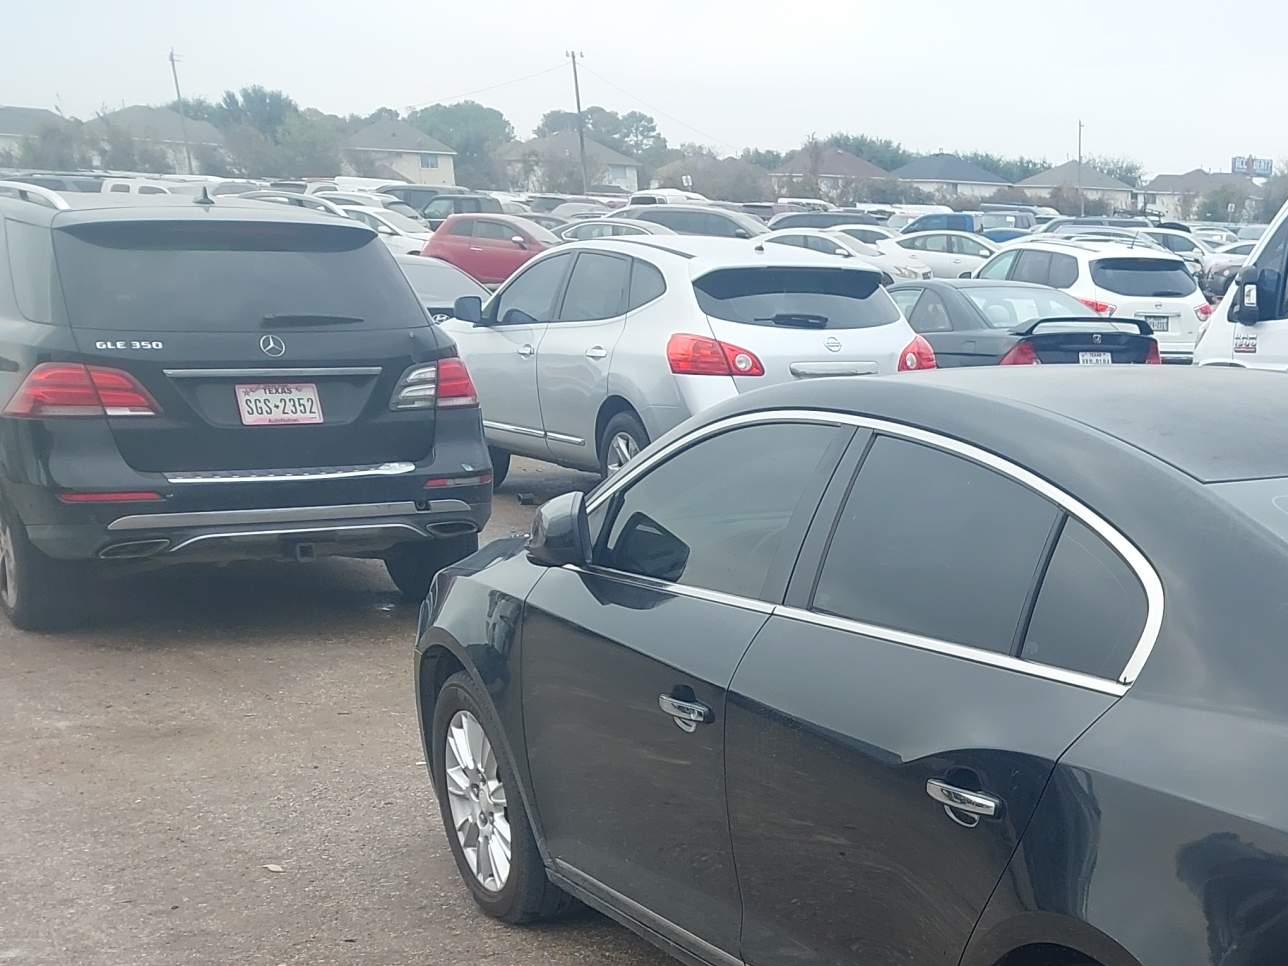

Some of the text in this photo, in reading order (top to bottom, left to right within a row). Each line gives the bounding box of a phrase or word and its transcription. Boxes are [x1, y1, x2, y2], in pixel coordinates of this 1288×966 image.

[95, 341, 163, 349] GLE 350
[263, 386, 293, 395] TEXAS
